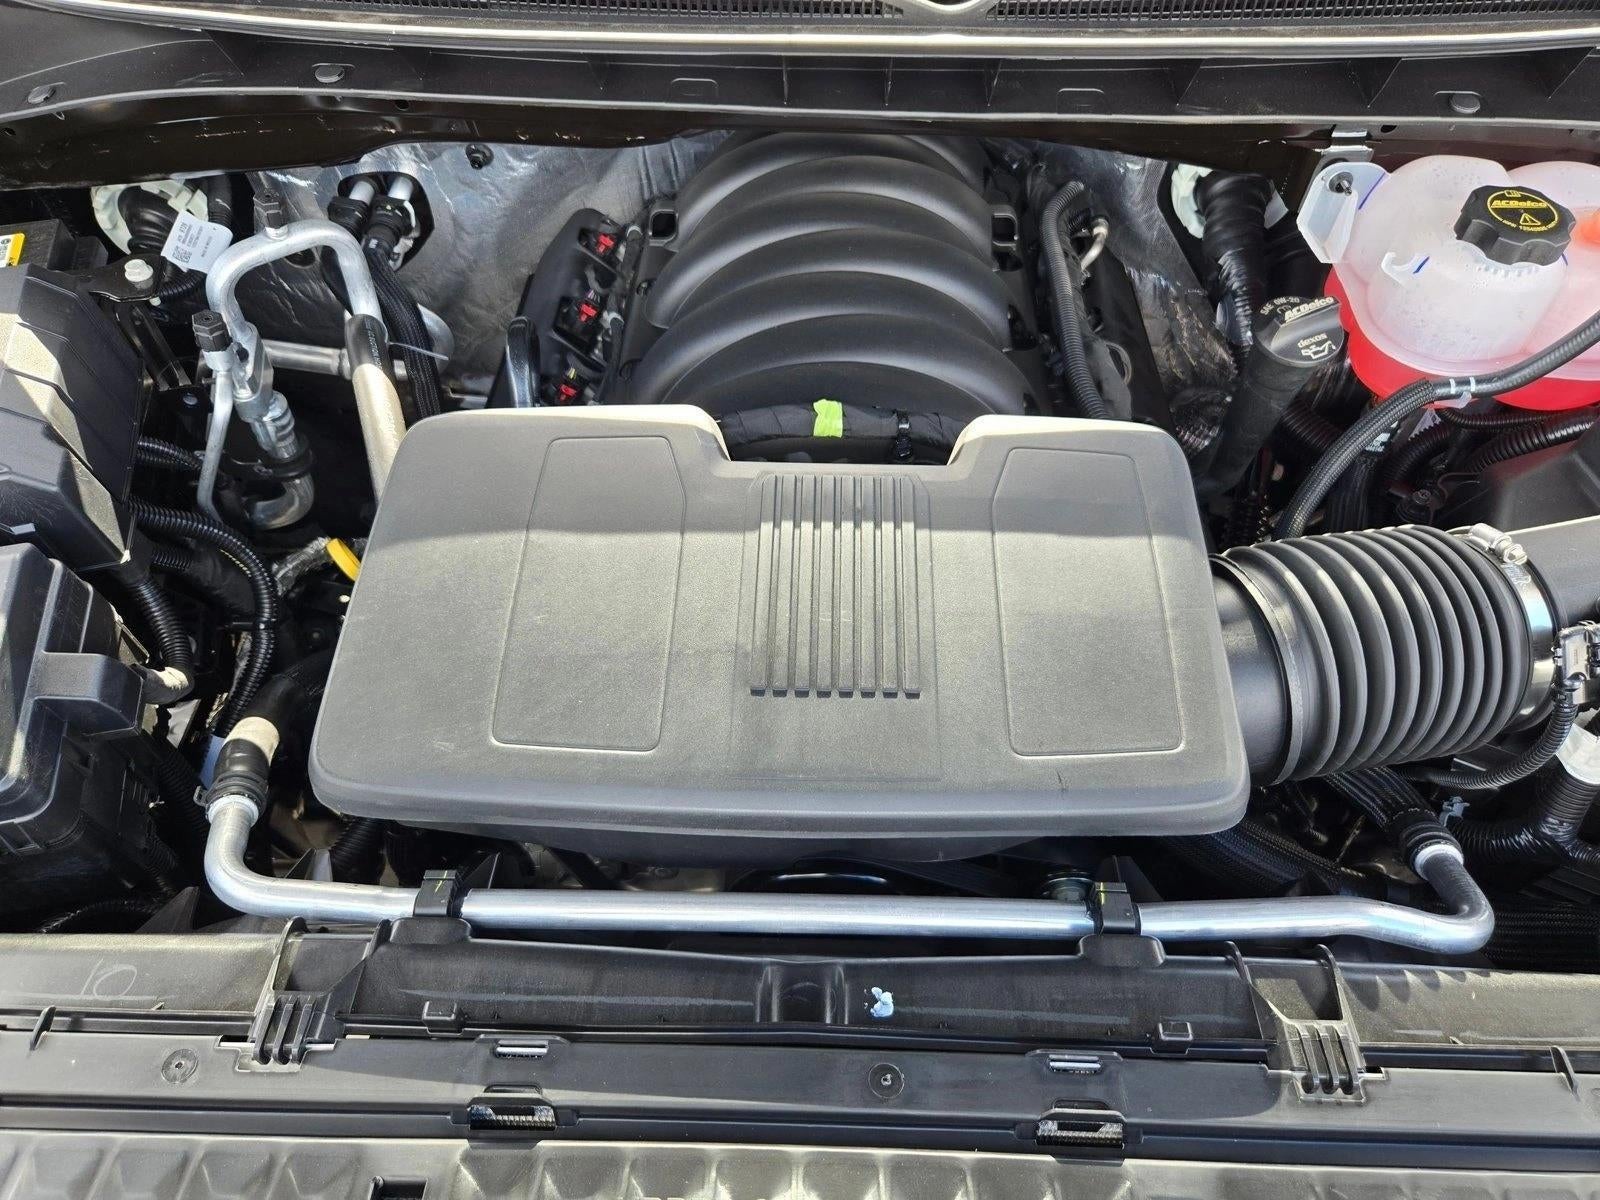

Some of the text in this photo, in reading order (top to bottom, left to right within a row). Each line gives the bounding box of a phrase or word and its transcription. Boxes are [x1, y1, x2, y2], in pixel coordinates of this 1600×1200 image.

[1490, 200, 1548, 209] ACDelco
[1260, 296, 1300, 316] SAE 0W-20
[1284, 296, 1335, 323] ACDelco
[1297, 332, 1328, 348] dexos
